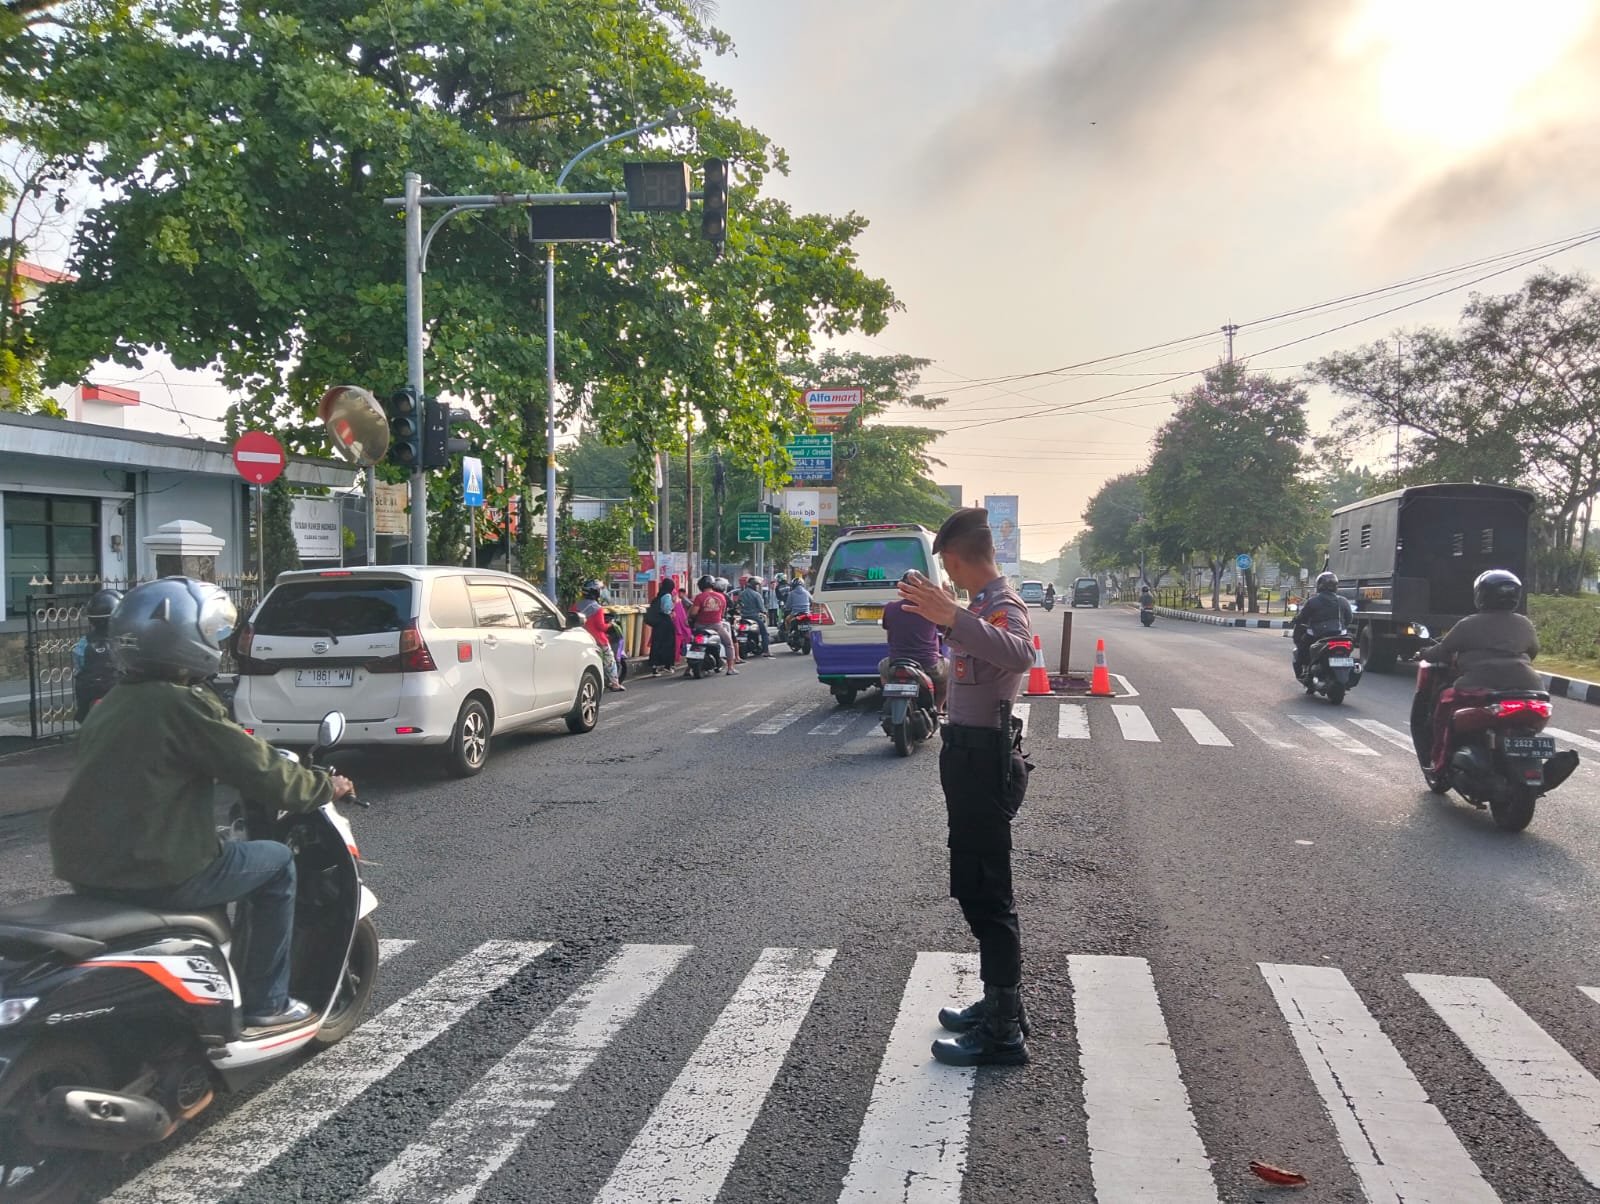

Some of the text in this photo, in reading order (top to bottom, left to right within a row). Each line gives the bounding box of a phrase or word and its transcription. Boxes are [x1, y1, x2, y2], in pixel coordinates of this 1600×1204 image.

[809, 392, 857, 403] Alfamart
[1364, 590, 1384, 600] POLISI
[297, 669, 352, 681] Z 1861 WN
